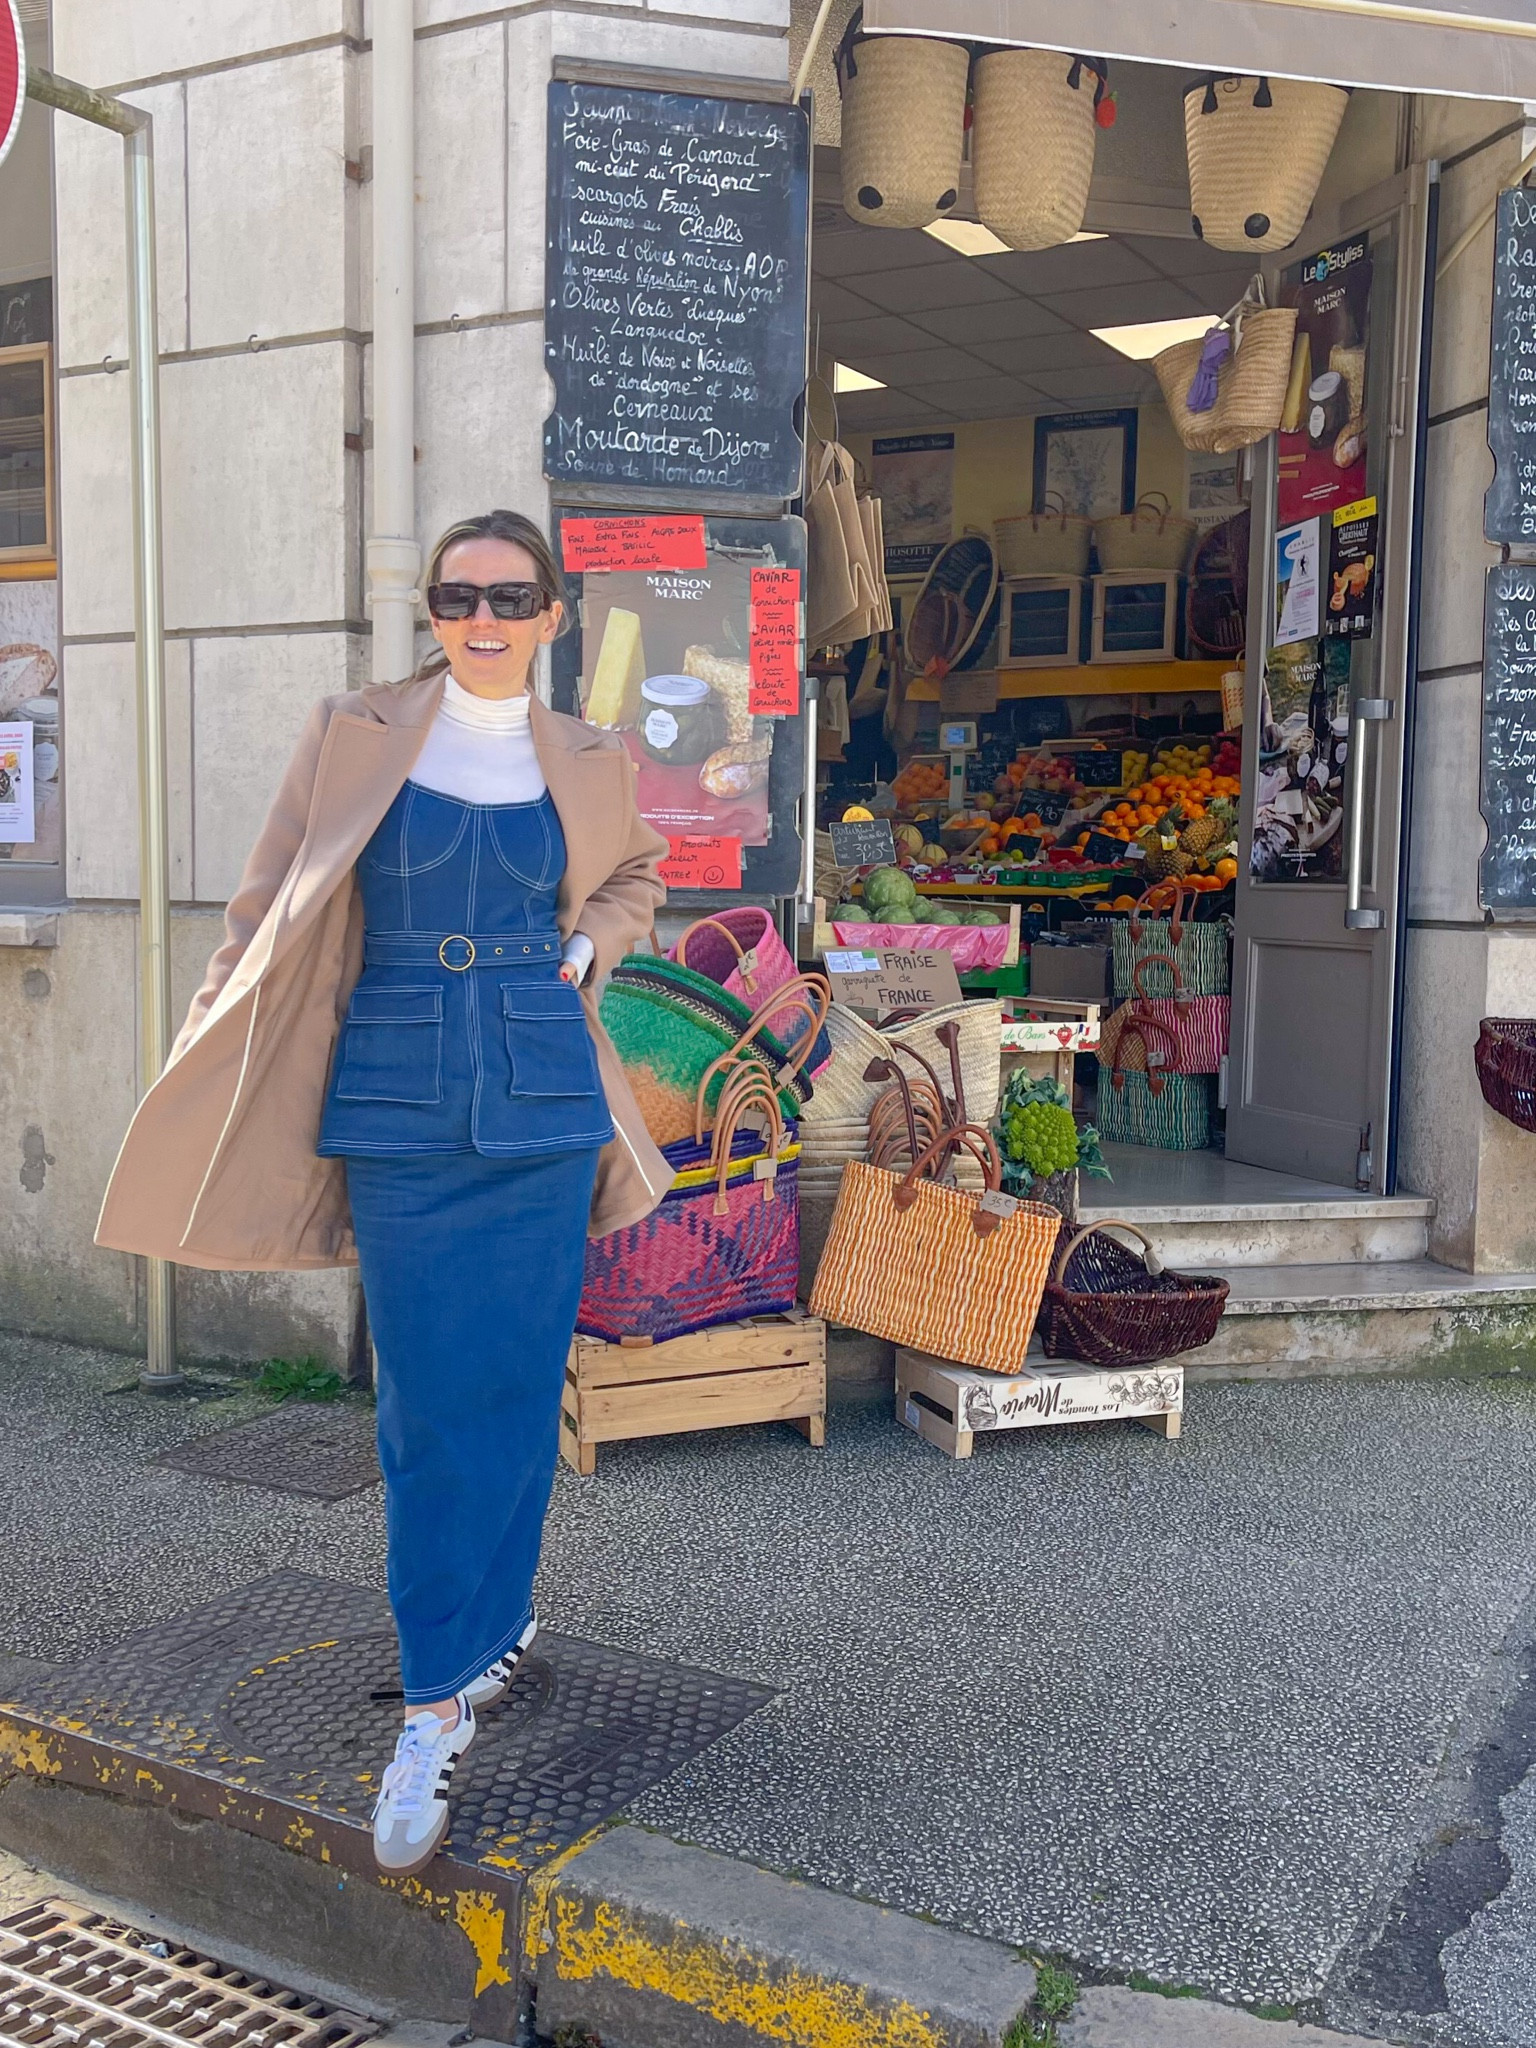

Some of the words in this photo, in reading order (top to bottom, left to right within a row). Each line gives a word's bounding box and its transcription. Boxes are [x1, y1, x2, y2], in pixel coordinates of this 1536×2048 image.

[658, 138, 673, 157] de
[687, 137, 760, 167] Canard
[648, 164, 666, 181] du
[657, 188, 701, 216] Frais
[643, 220, 662, 232] au
[679, 214, 744, 243] Chablis
[681, 248, 733, 273] noires
[582, 263, 631, 286] grande
[703, 277, 718, 294] de
[562, 281, 621, 315] Olives
[626, 292, 674, 320] Vertes
[1314, 286, 1348, 307] MAISON
[562, 334, 612, 365] Huile
[619, 347, 636, 367] de
[589, 371, 606, 387] de
[558, 416, 681, 456] Moutarde
[688, 438, 704, 458] de
[700, 427, 773, 466] Dijon
[646, 576, 712, 590] MAISON
[765, 585, 777, 594] de
[655, 587, 703, 600] MARC
[1290, 661, 1322, 674] MAISON
[766, 690, 777, 698] de
[898, 973, 914, 983] de
[878, 988, 936, 1006] FRANCE
[1004, 1028, 1016, 1040] de
[1058, 1404, 1100, 1416] Tomates
[1060, 1398, 1073, 1408] de
[1102, 1403, 1120, 1413] Los
